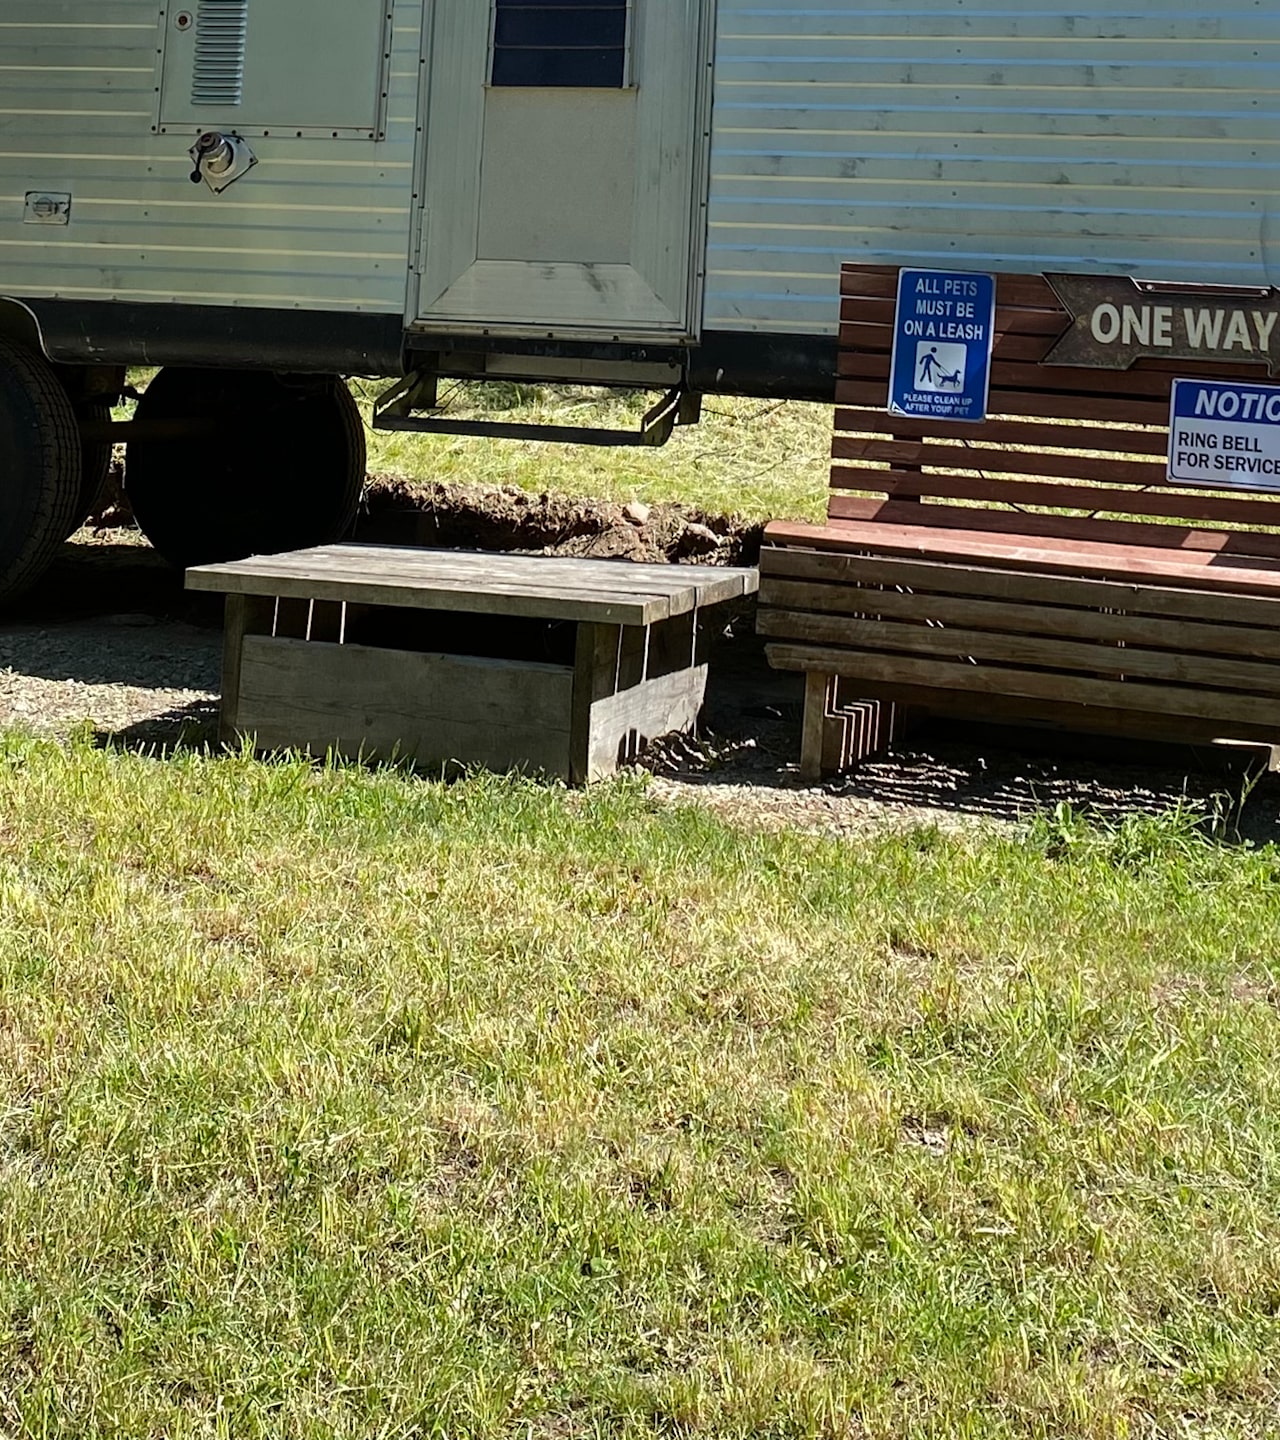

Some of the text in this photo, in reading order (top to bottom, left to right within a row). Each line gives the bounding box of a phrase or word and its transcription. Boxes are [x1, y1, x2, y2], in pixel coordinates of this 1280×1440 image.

[915, 278, 978, 297] ALL PETS
[916, 299, 974, 318] MUST BE
[904, 319, 984, 340] ON A LEASH
[1090, 302, 1279, 354] ONE WAY
[903, 393, 932, 403] PLEASE
[933, 395, 960, 405] CLEAN
[904, 401, 970, 415] AFTER YOUR PET
[1178, 431, 1263, 453] RING BELL
[1177, 451, 1210, 469] FOR
